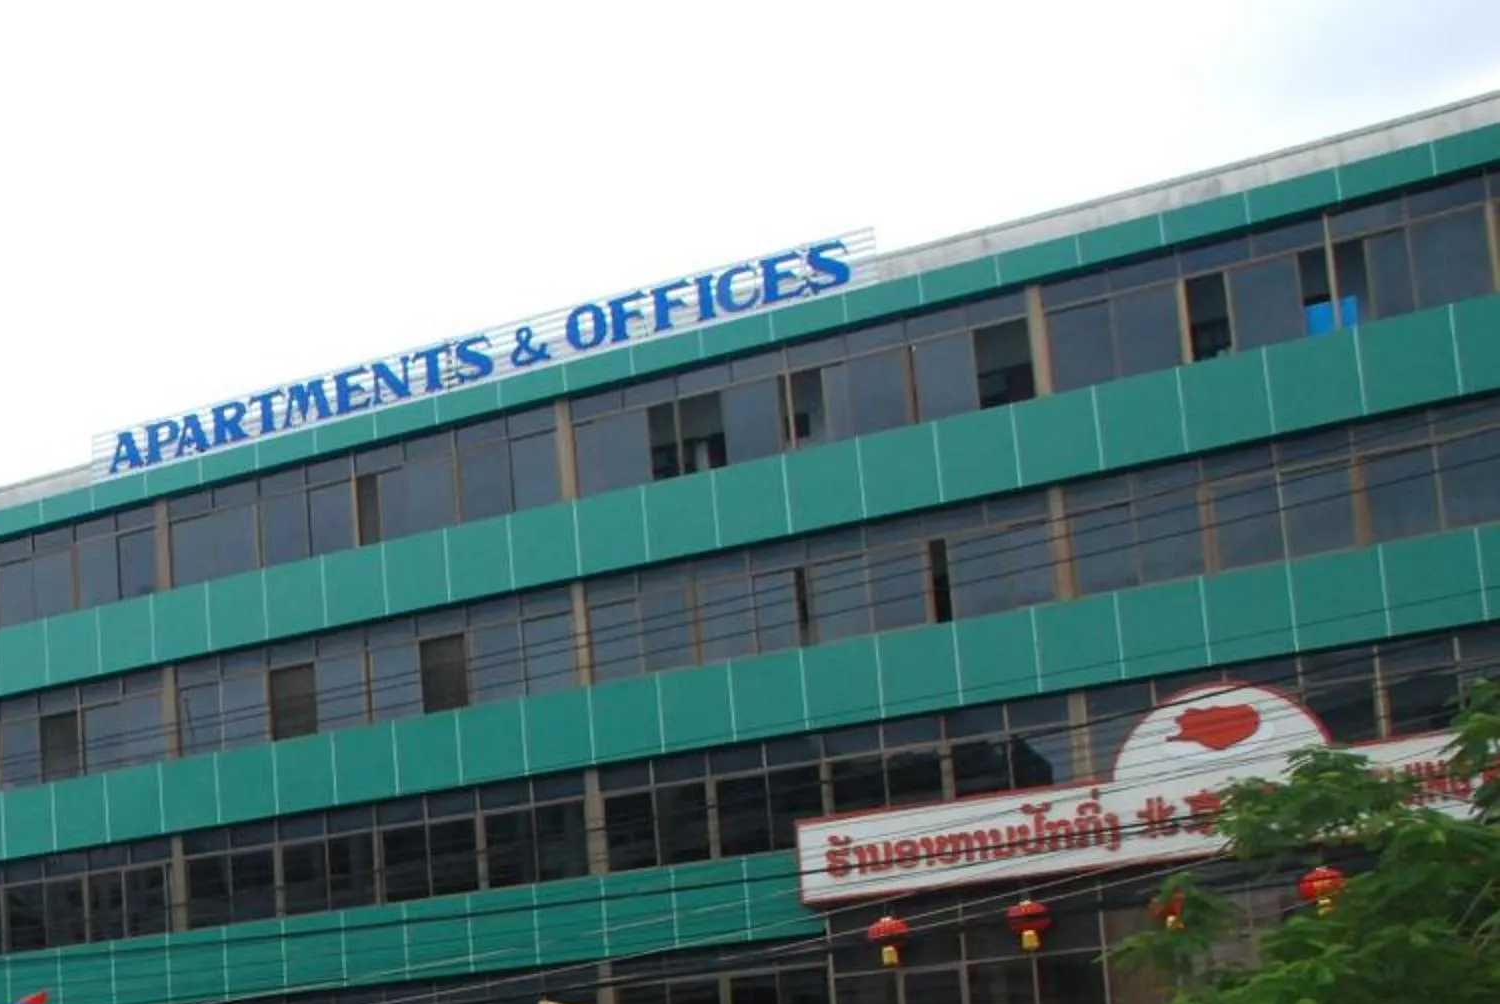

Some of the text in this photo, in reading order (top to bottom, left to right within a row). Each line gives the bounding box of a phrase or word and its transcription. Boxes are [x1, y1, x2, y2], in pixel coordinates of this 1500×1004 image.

[109, 240, 850, 474] APARTMENTS & OFFICES
